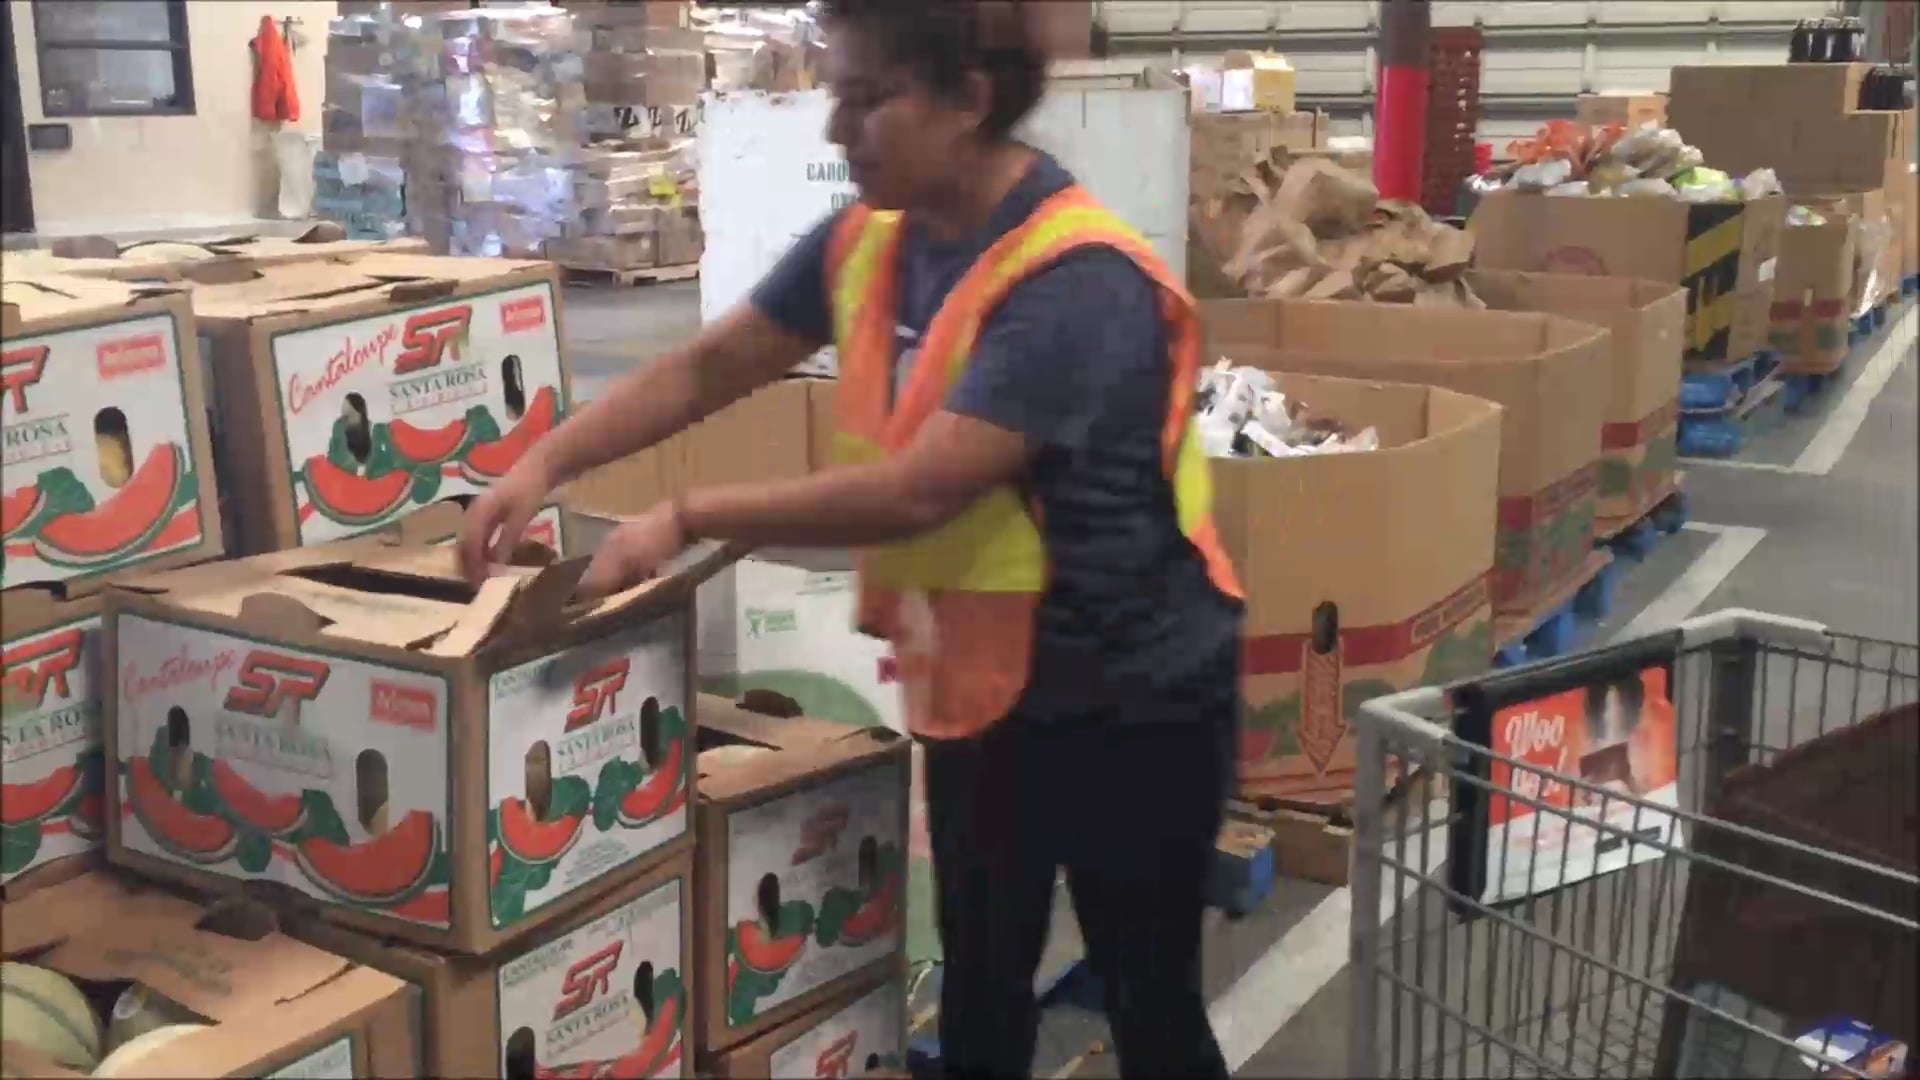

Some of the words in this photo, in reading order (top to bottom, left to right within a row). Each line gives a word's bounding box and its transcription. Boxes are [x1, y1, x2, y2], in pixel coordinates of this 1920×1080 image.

[288, 323, 399, 415] Cantaloupe
[394, 304, 472, 374] SR
[389, 375, 444, 399] SANTA
[446, 365, 489, 388] ROSA
[6, 420, 69, 447] ROSA
[223, 650, 330, 719] SR
[564, 656, 631, 734] SR
[556, 728, 604, 757] SANTA
[553, 940, 624, 1022] SR
[546, 1011, 591, 1043] SANTA
